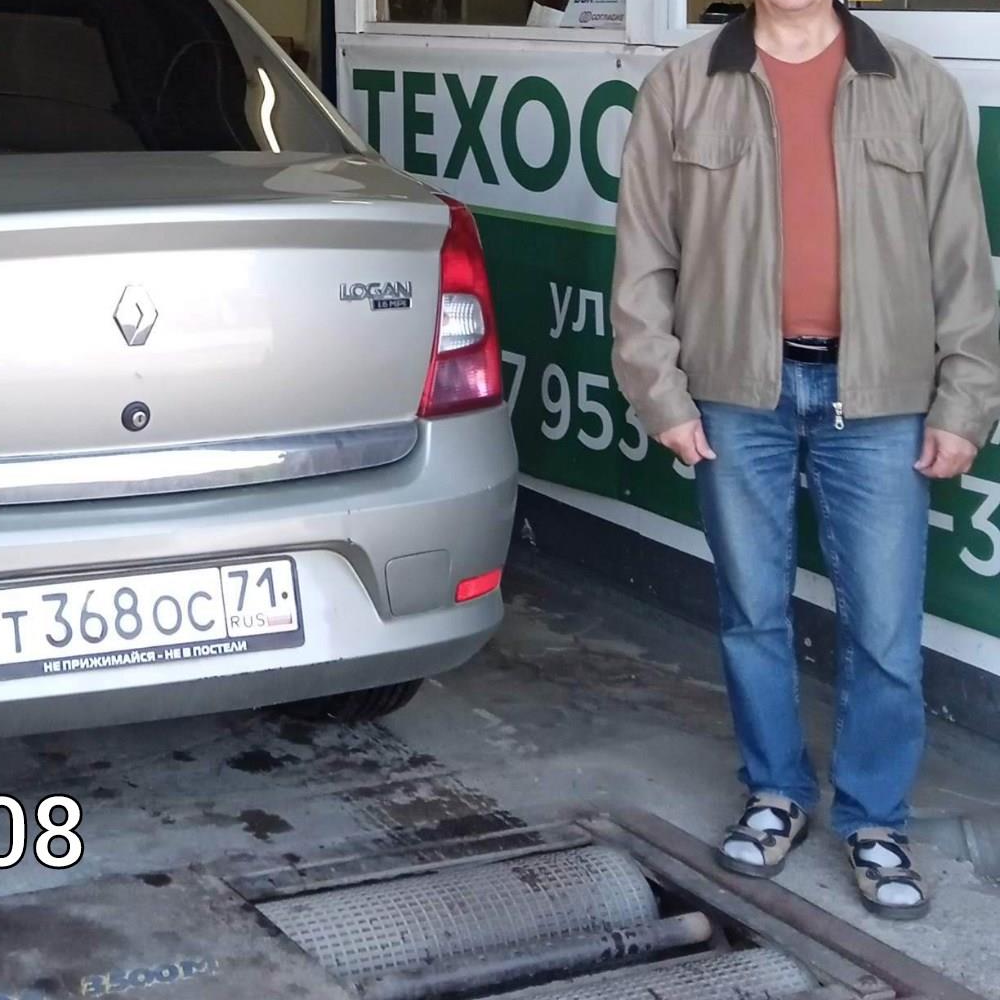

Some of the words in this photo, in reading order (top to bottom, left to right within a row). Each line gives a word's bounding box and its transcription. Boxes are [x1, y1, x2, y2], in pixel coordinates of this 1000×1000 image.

[340, 281, 412, 301] LOGAN
[228, 567, 277, 612] 71
[231, 614, 265, 629] RUS
[43, 661, 61, 673] НЕ
[63, 650, 155, 671] ПРИЖИМАЙСЯ
[165, 649, 181, 660] НЕ
[193, 640, 248, 657] ПОСТЕЛИ
